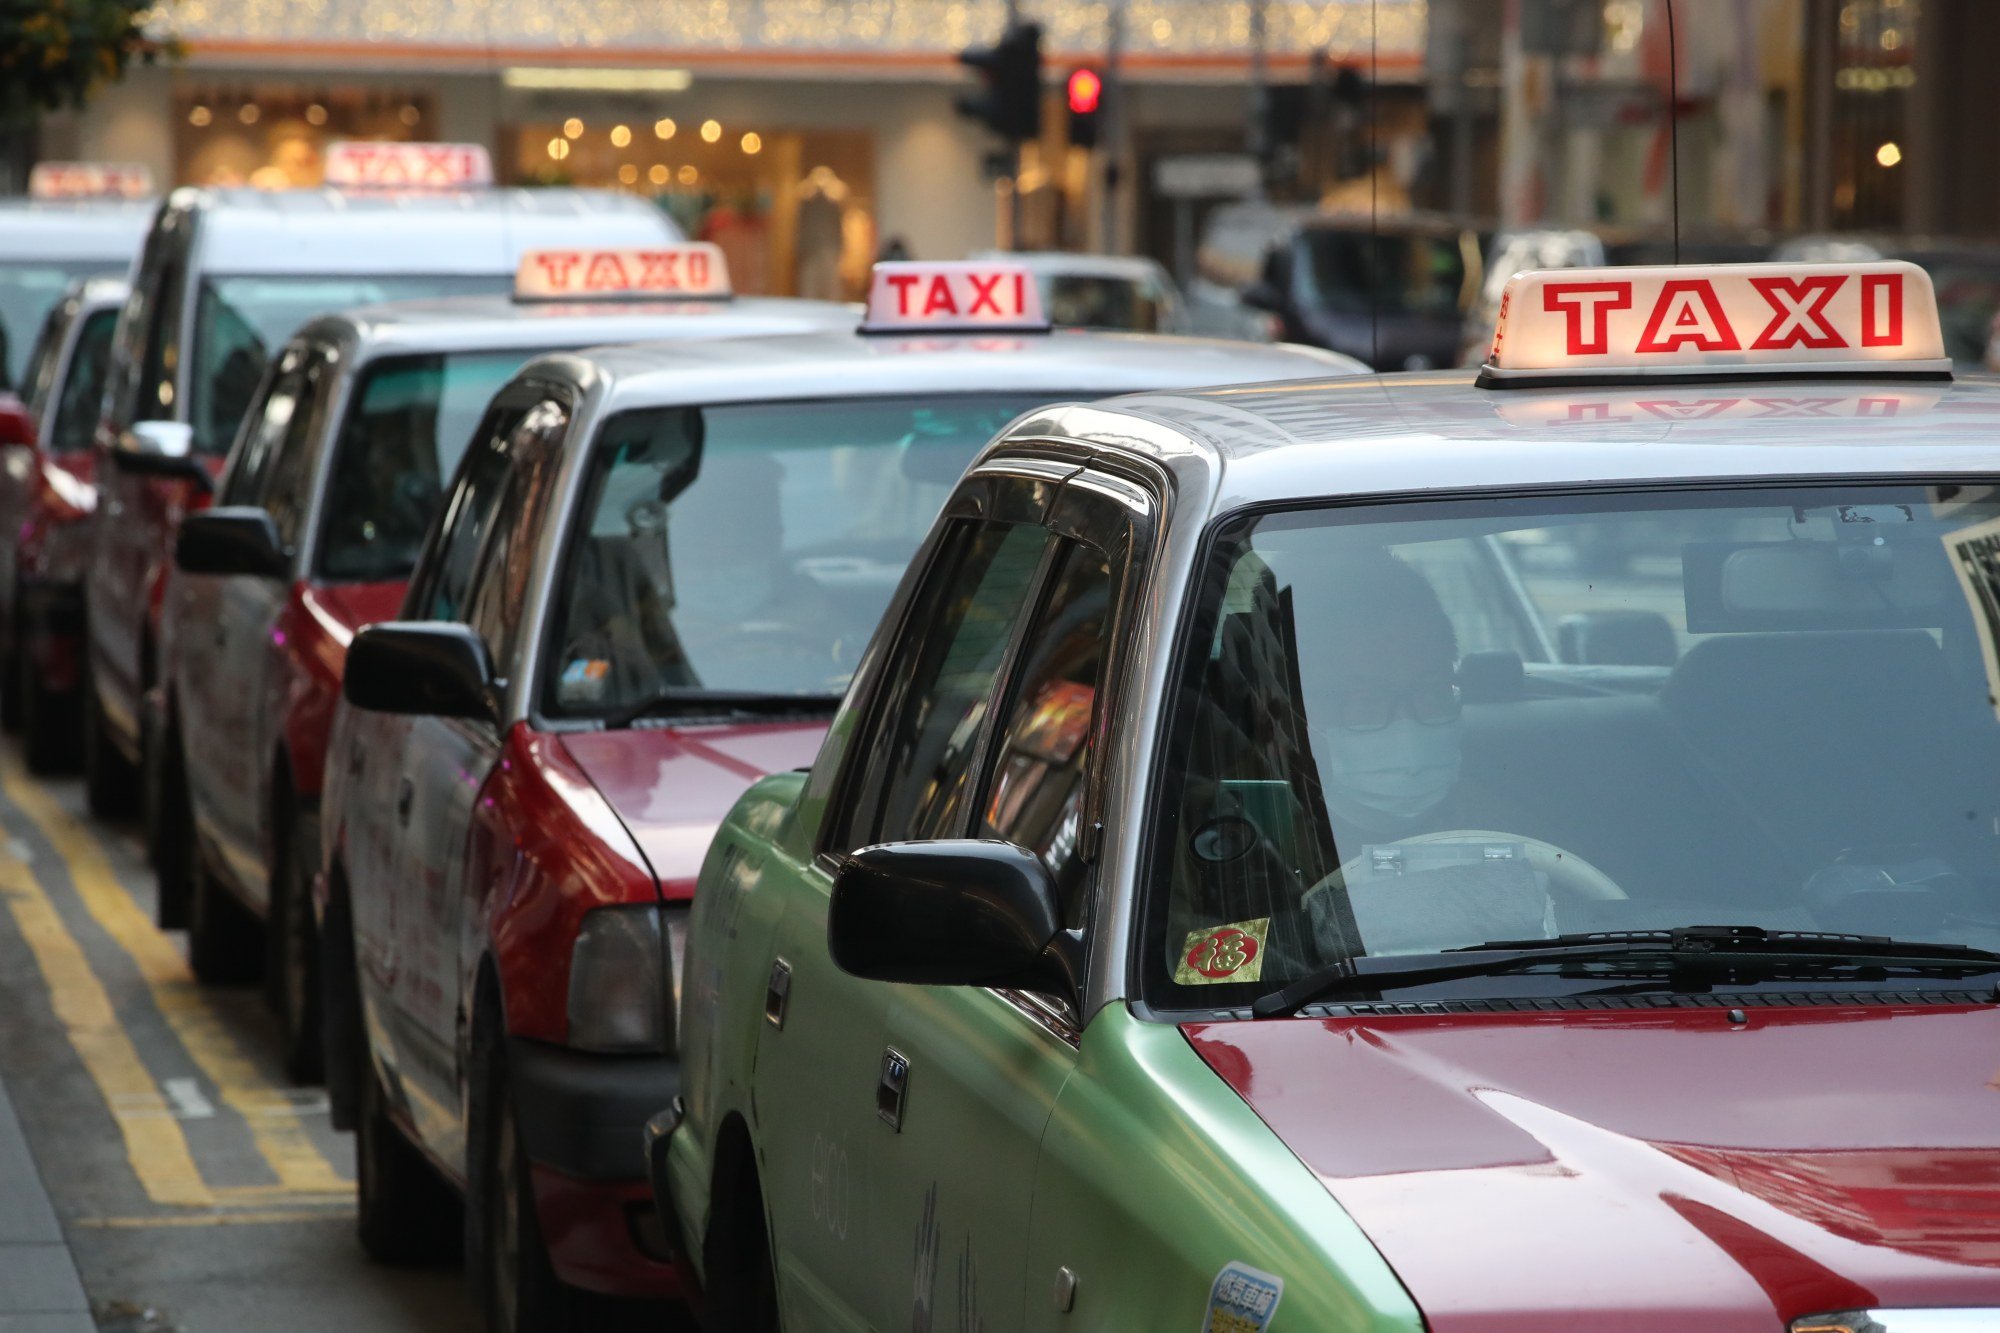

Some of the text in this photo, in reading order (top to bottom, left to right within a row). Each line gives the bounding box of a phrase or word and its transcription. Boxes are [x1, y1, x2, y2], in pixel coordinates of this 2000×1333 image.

[535, 252, 711, 290] TAXI
[887, 274, 1025, 316] TAXI
[1543, 273, 1904, 356] TAXI
[1194, 932, 1248, 972] 福
